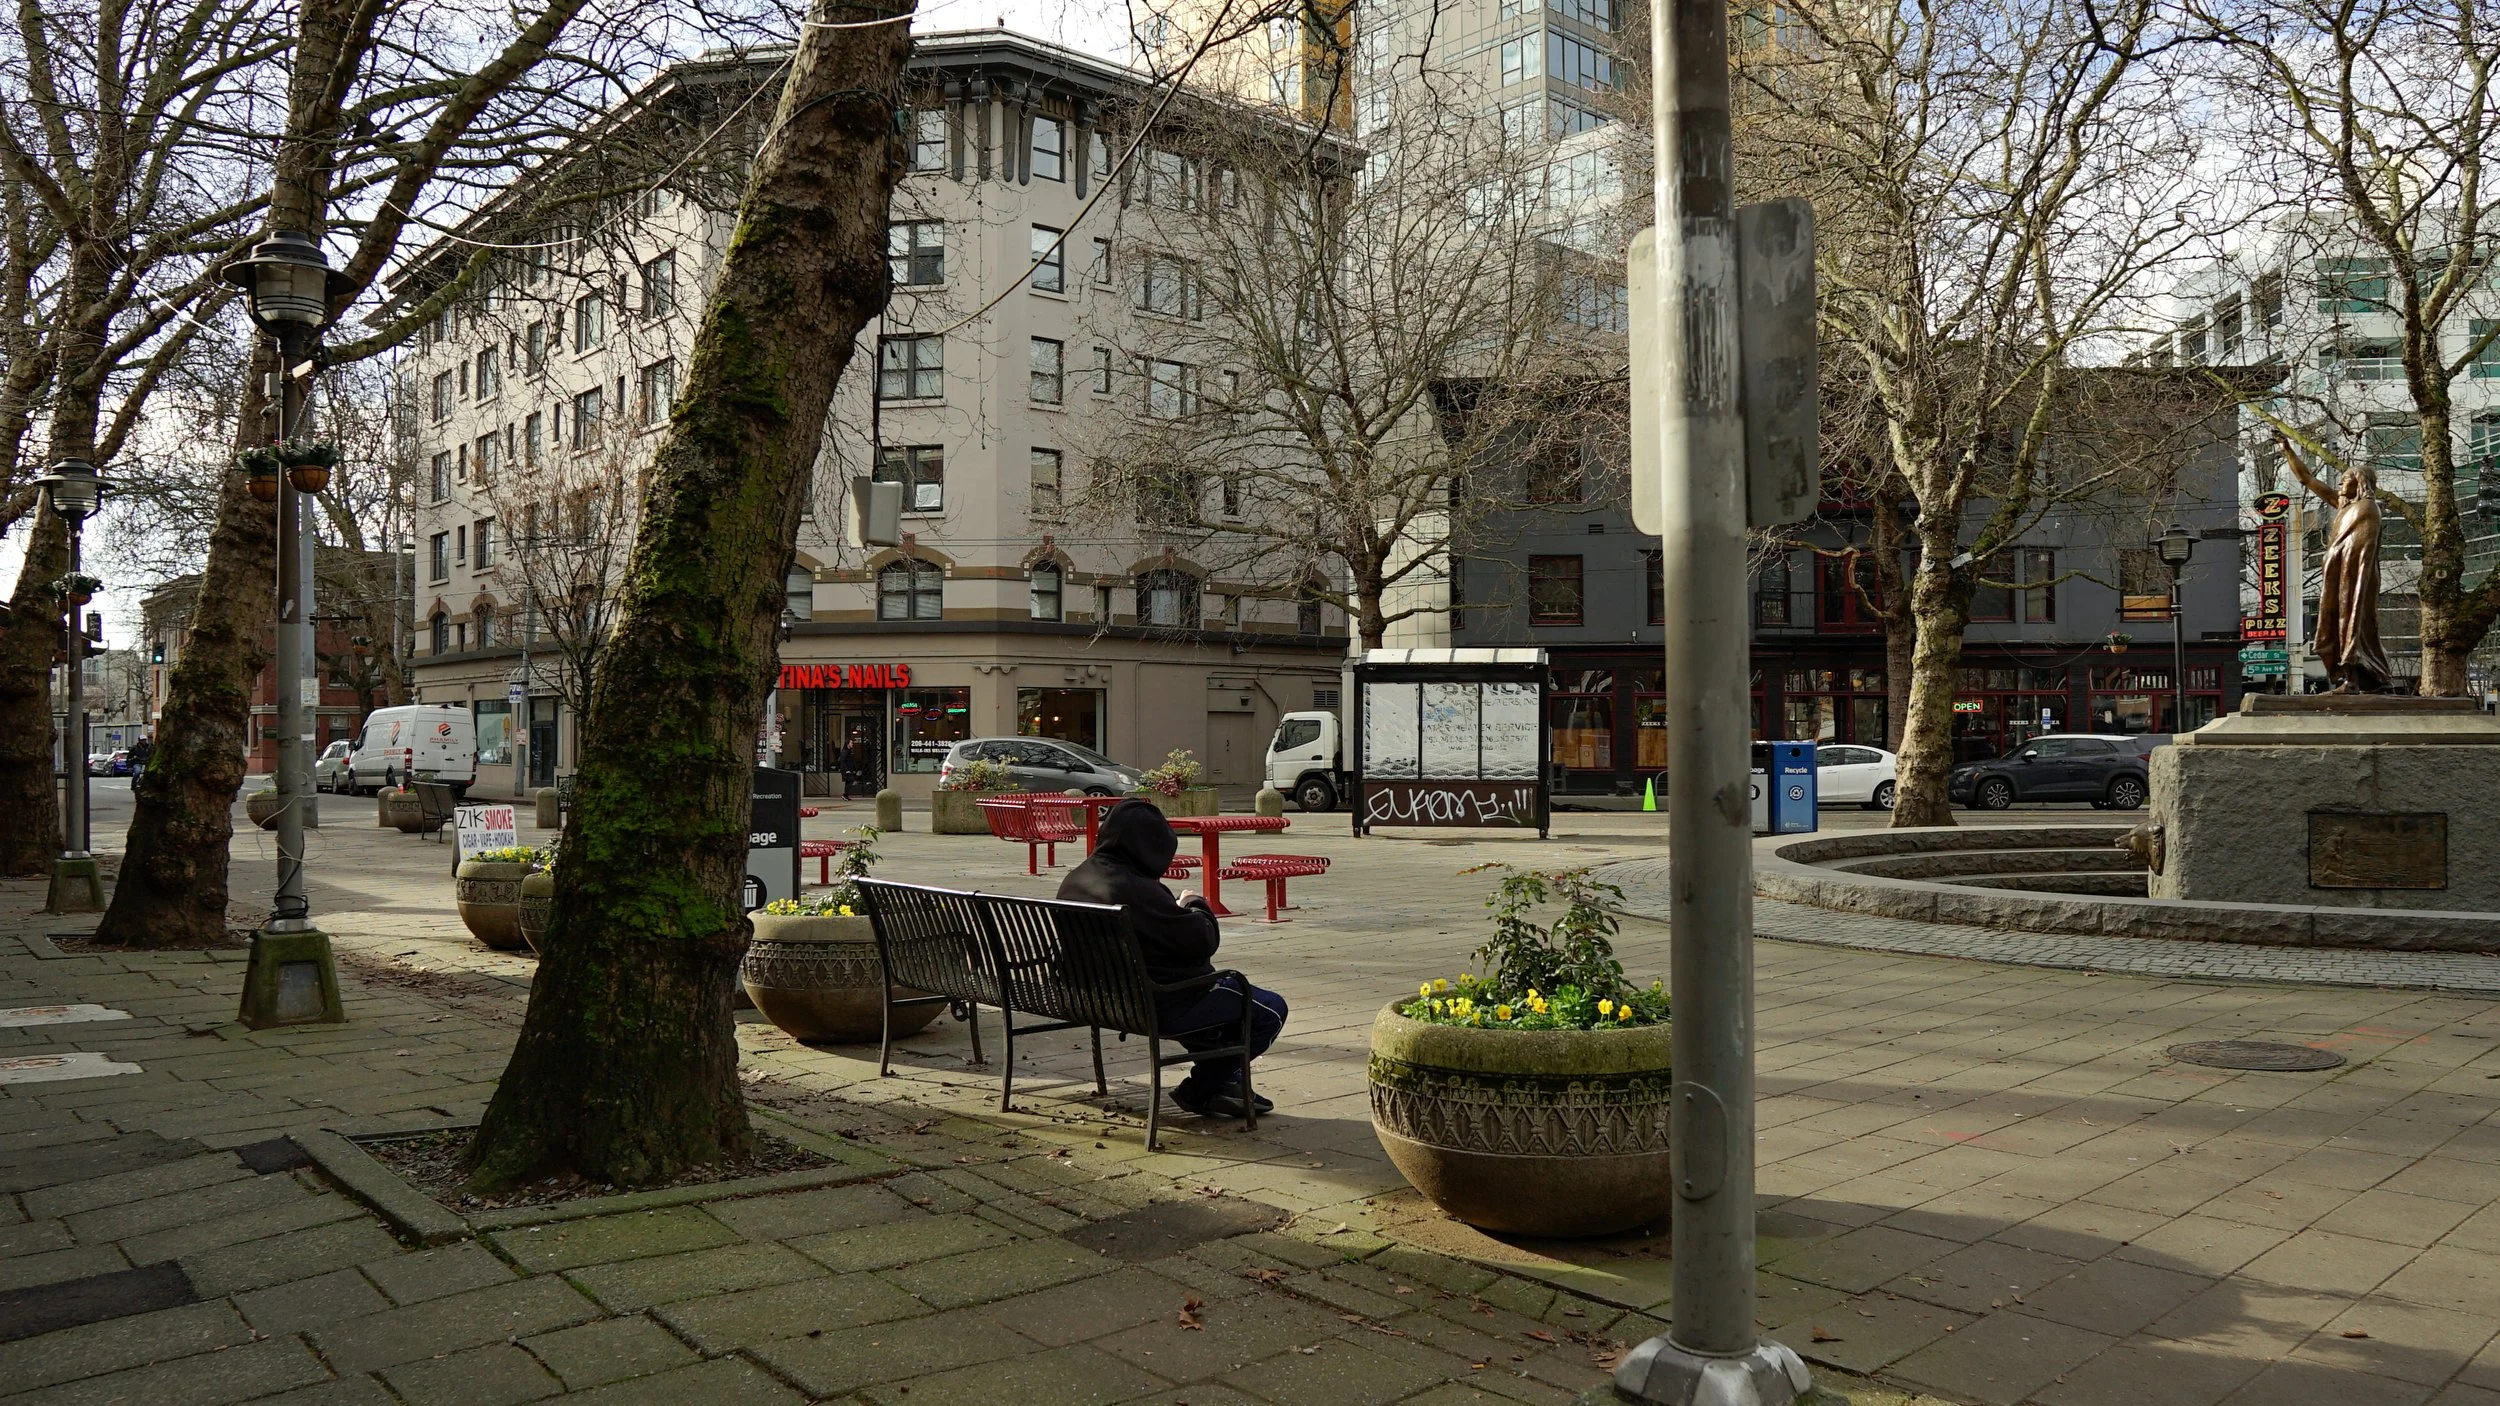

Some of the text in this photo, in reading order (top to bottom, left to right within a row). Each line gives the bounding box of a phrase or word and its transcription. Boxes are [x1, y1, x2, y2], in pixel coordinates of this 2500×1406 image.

[2264, 527, 2281, 614] ZEEKS
[2245, 618, 2287, 630] PIZZ
[2248, 651, 2269, 659] Cedar
[848, 664, 910, 689] NAILS
[1953, 702, 1981, 711] OPEN
[752, 792, 782, 800] Recreation
[457, 808, 513, 831] ZIK SMOKE
